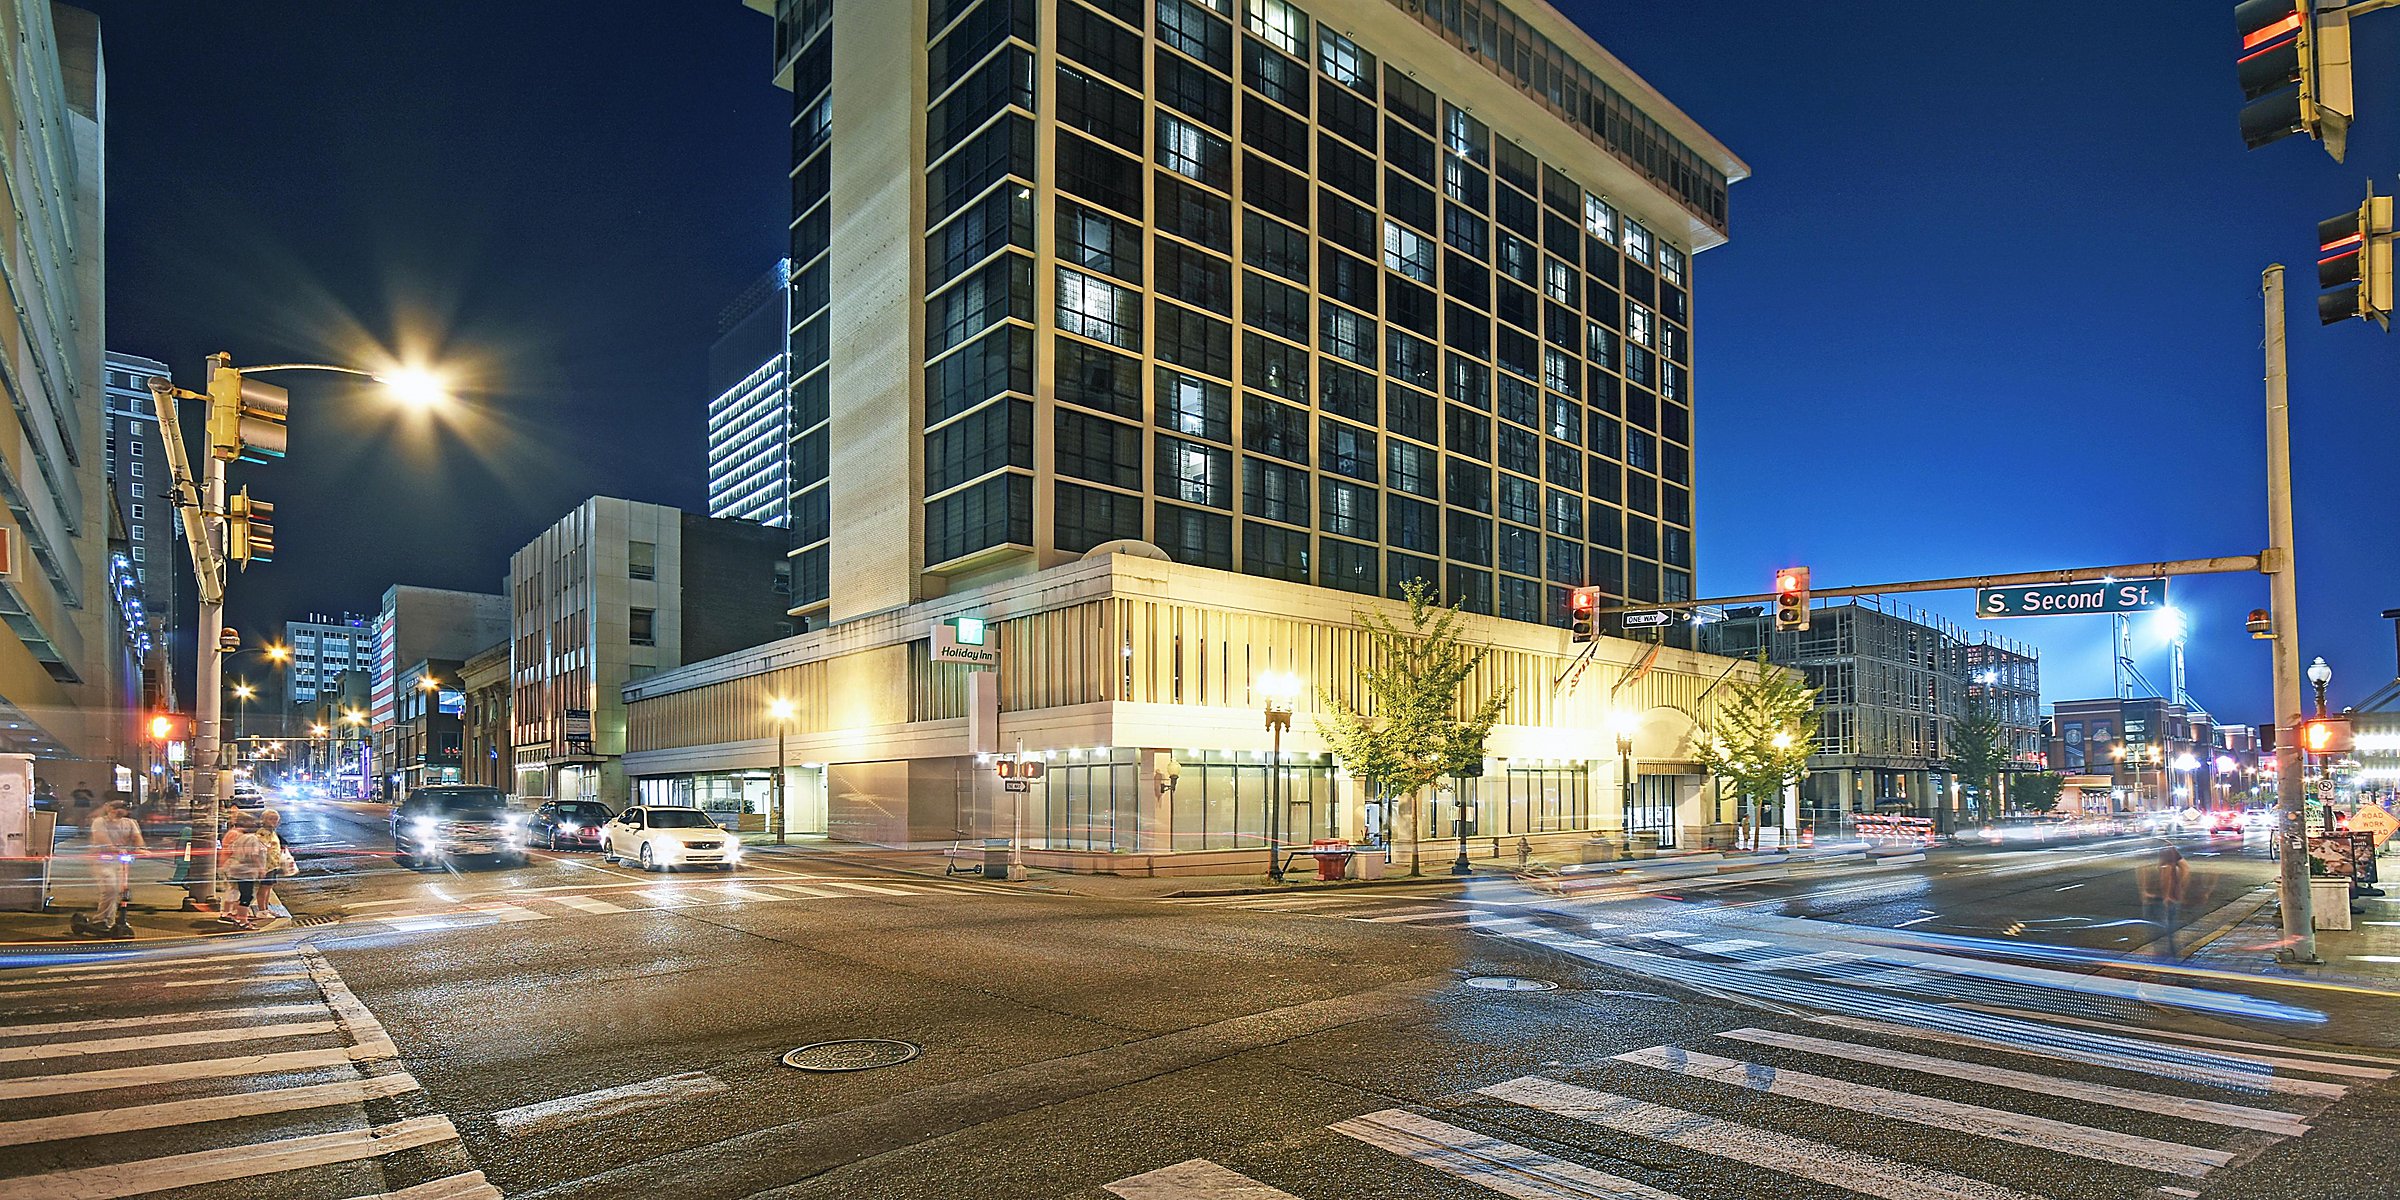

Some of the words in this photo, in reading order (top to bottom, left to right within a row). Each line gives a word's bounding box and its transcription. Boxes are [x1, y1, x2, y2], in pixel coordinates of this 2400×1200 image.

[1986, 593, 2011, 613] S.
[2022, 588, 2105, 611] Second
[2118, 585, 2155, 606] St.
[941, 646, 979, 661] Holiday
[979, 649, 993, 660] Inn
